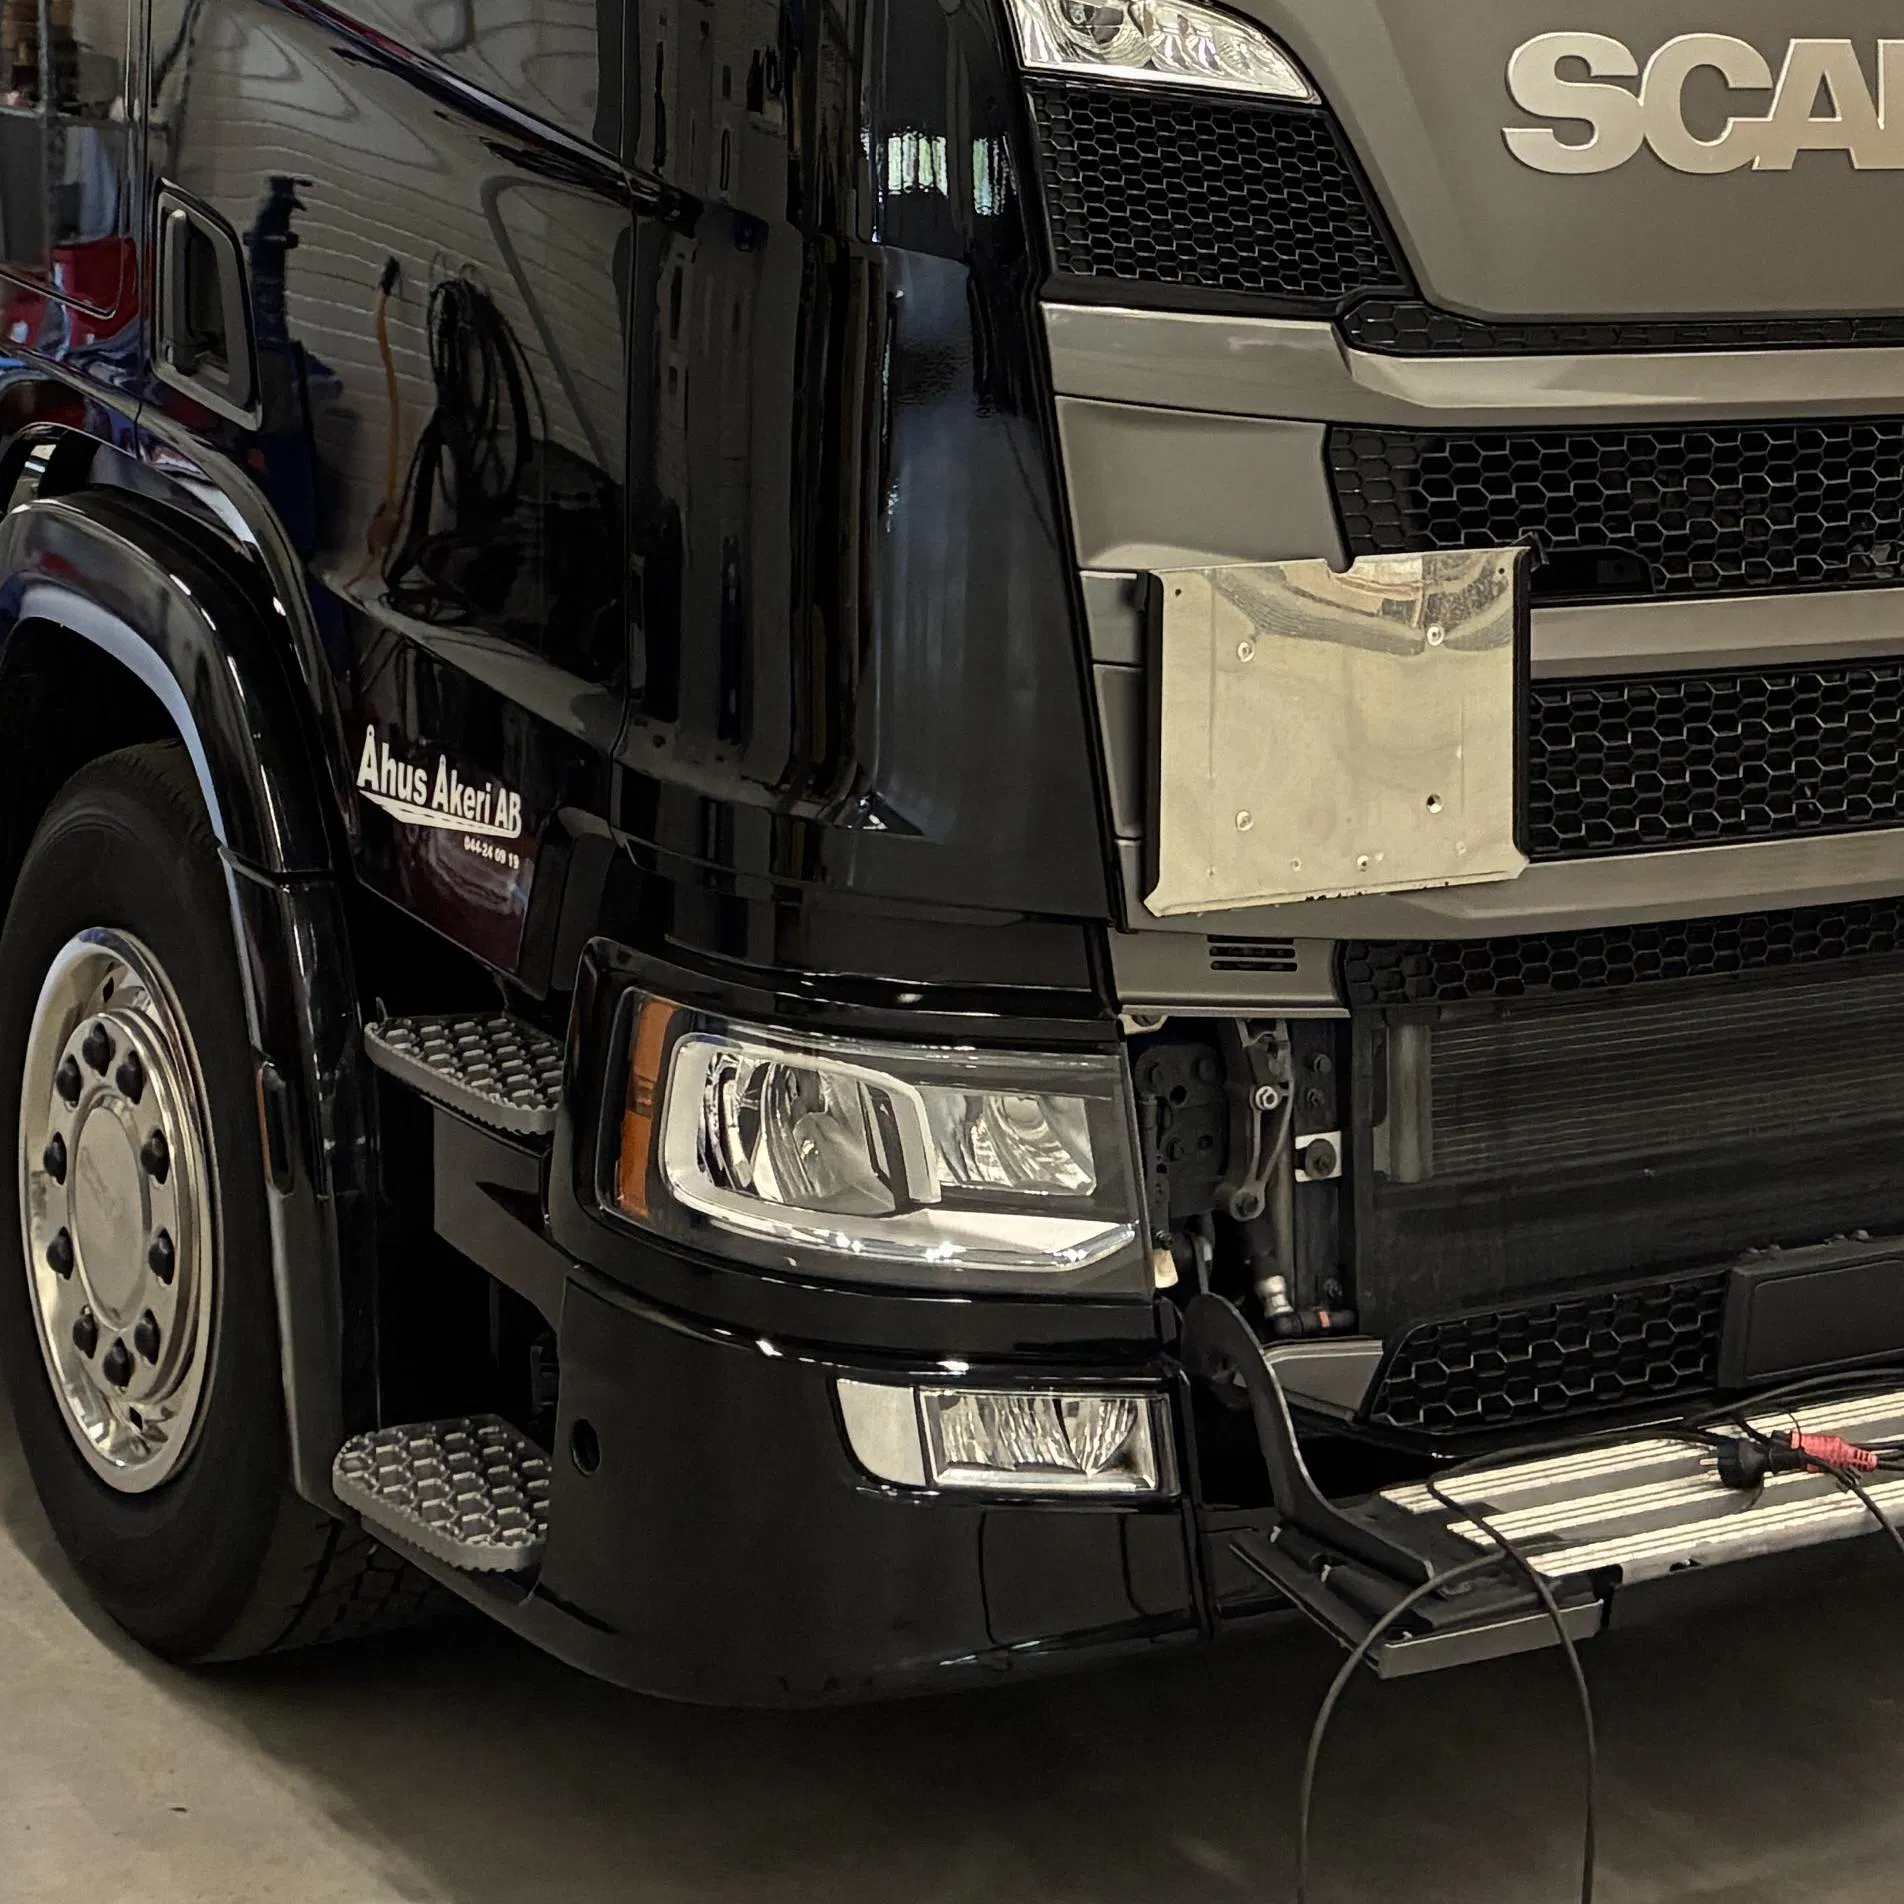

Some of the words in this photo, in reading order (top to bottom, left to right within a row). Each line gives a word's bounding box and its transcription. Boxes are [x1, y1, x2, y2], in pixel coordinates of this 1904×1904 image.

[356, 723, 428, 806] Åhus
[431, 753, 493, 825] Åkeri
[494, 787, 523, 833] AB
